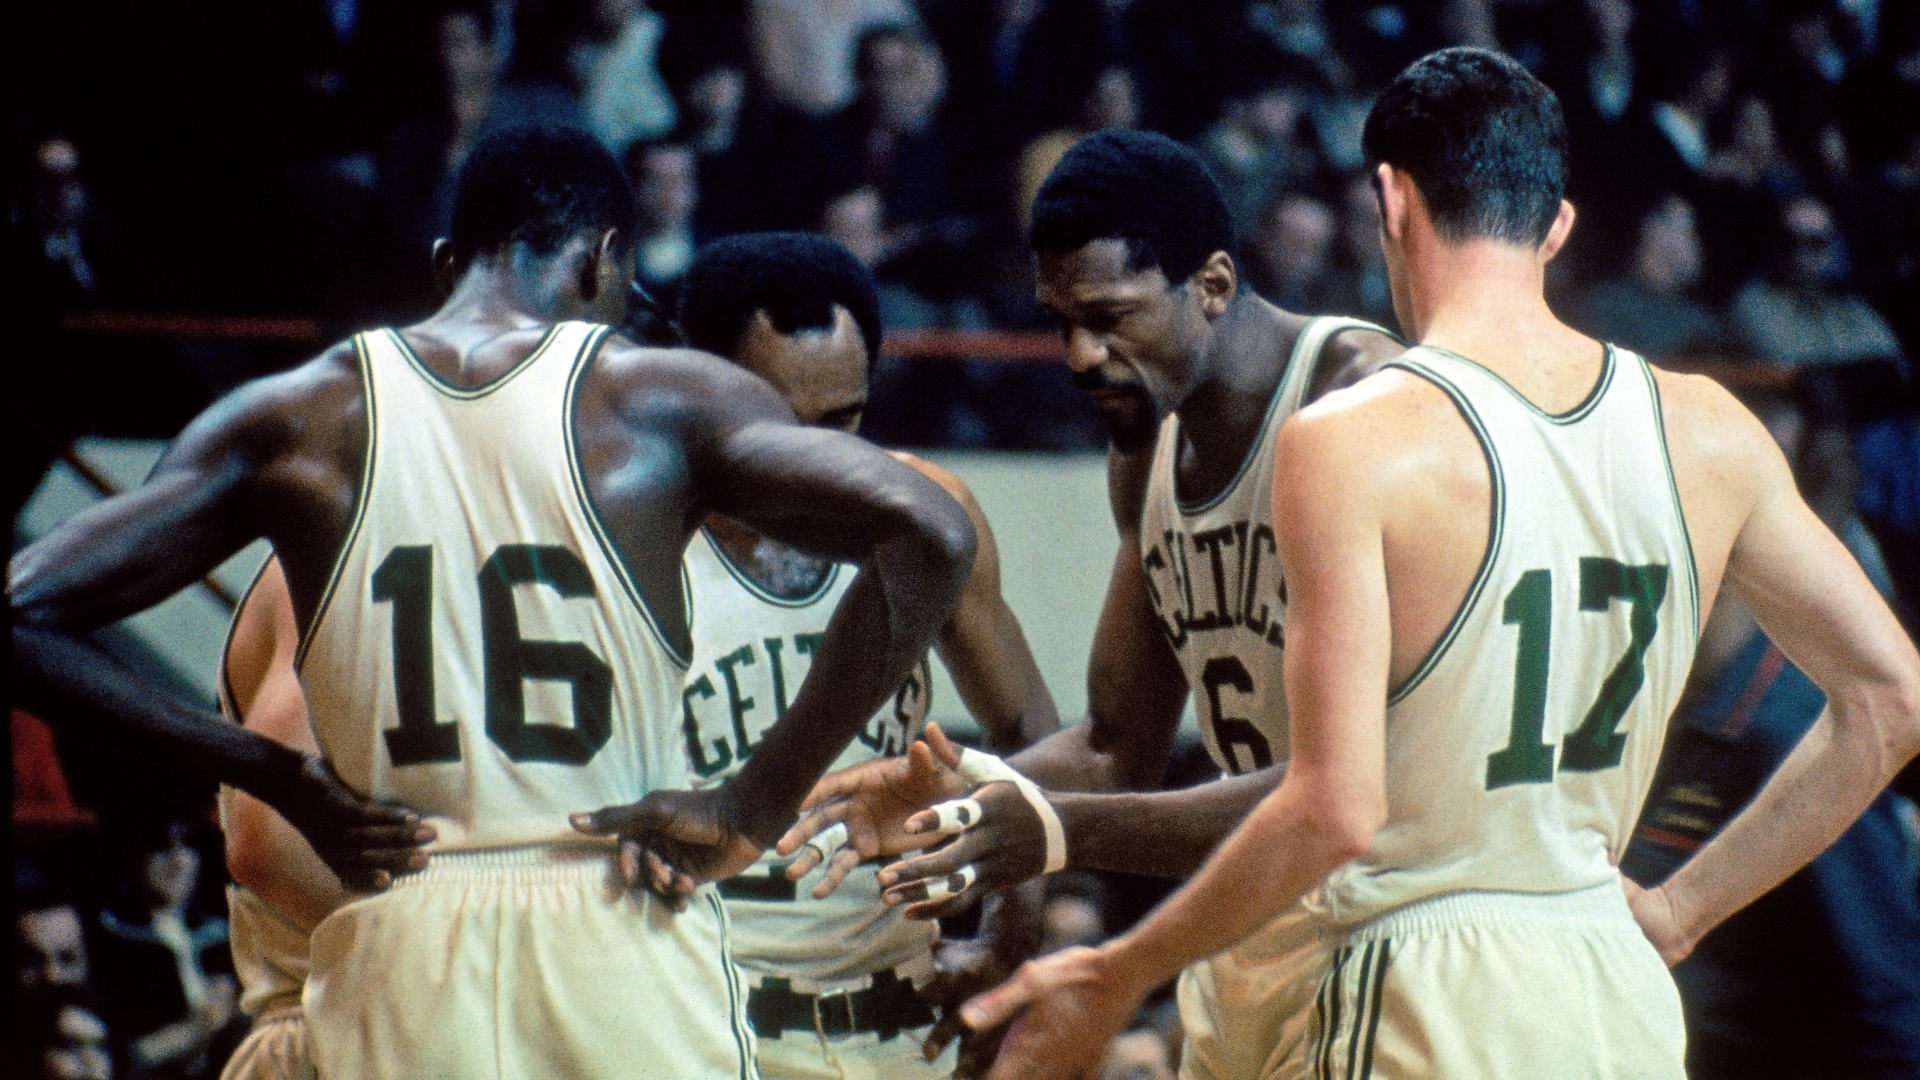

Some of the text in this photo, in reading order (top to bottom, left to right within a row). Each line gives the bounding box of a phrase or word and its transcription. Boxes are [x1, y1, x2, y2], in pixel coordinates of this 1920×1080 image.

[371, 543, 613, 767] 16
[681, 631, 922, 778] CELS
[1202, 655, 1273, 776] 6
[1485, 556, 1669, 792] 17
